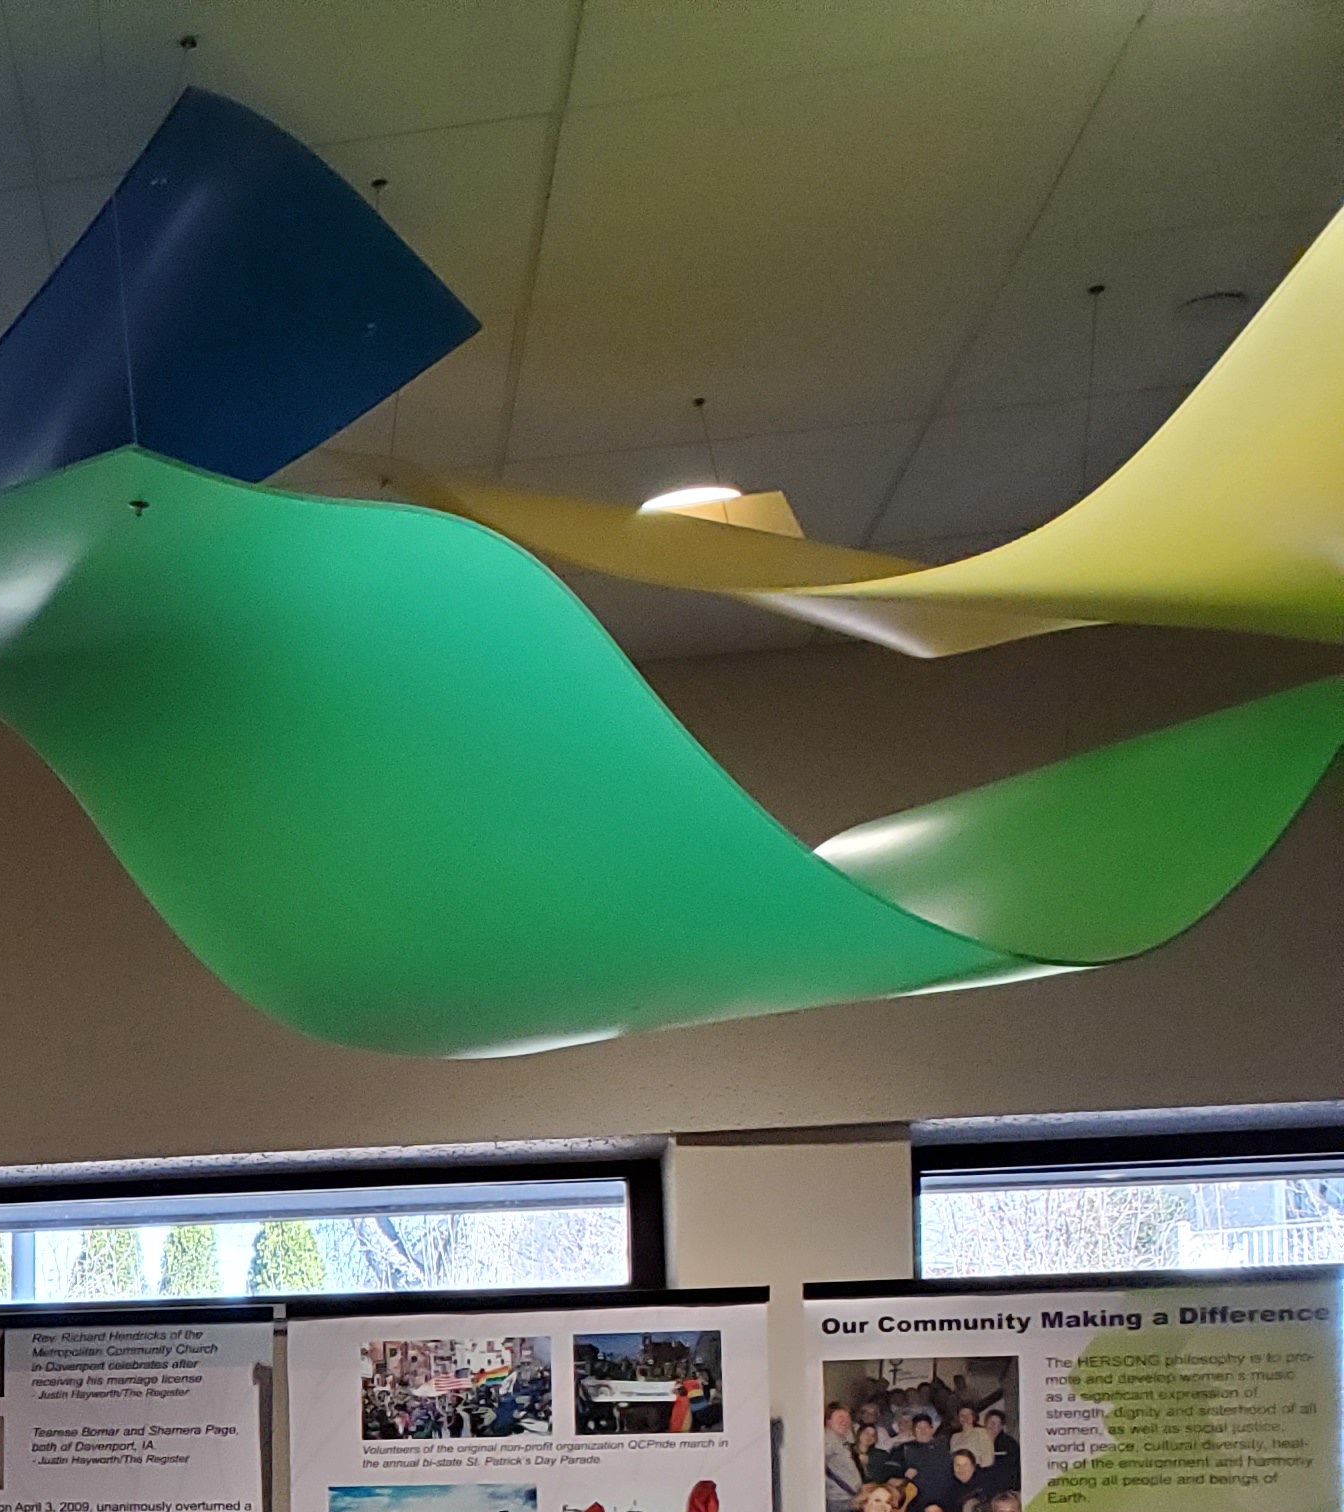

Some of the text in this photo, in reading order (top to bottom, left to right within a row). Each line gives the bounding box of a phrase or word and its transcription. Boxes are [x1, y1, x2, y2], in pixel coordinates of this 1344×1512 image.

[821, 1305, 1329, 1336] Our Community Making a Difference
[14, 1501, 42, 1512] April
[96, 1501, 173, 1512] unanimously
[174, 1501, 240, 1511] overturned
[243, 1502, 252, 1511] a
